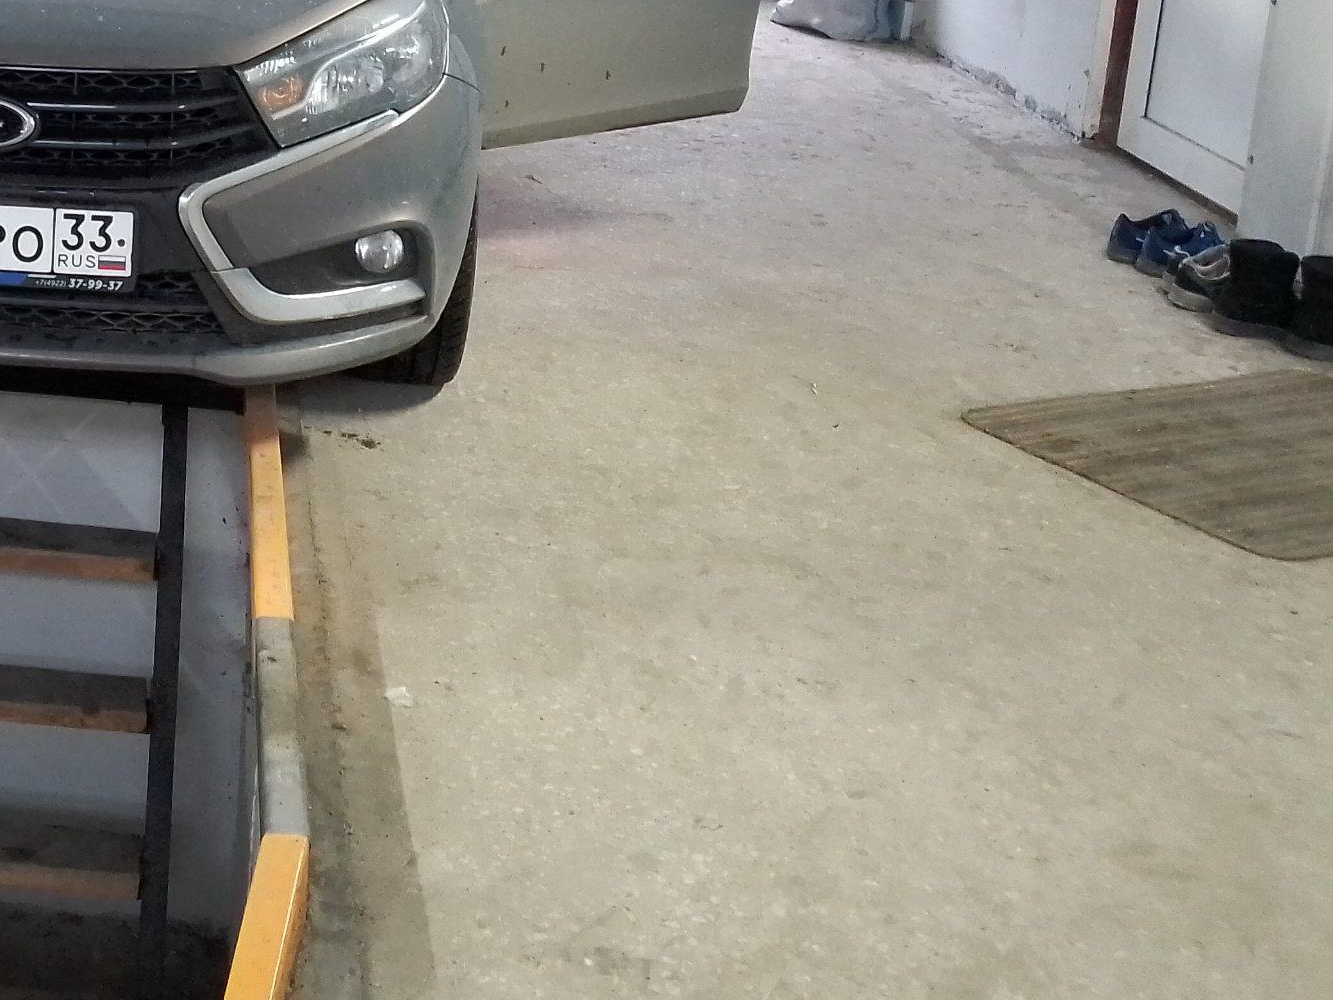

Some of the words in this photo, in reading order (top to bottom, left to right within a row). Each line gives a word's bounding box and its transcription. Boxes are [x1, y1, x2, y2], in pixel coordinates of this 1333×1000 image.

[61, 213, 114, 252] 33
[57, 254, 96, 270] RUS
[68, 277, 123, 291] 37-99-37
